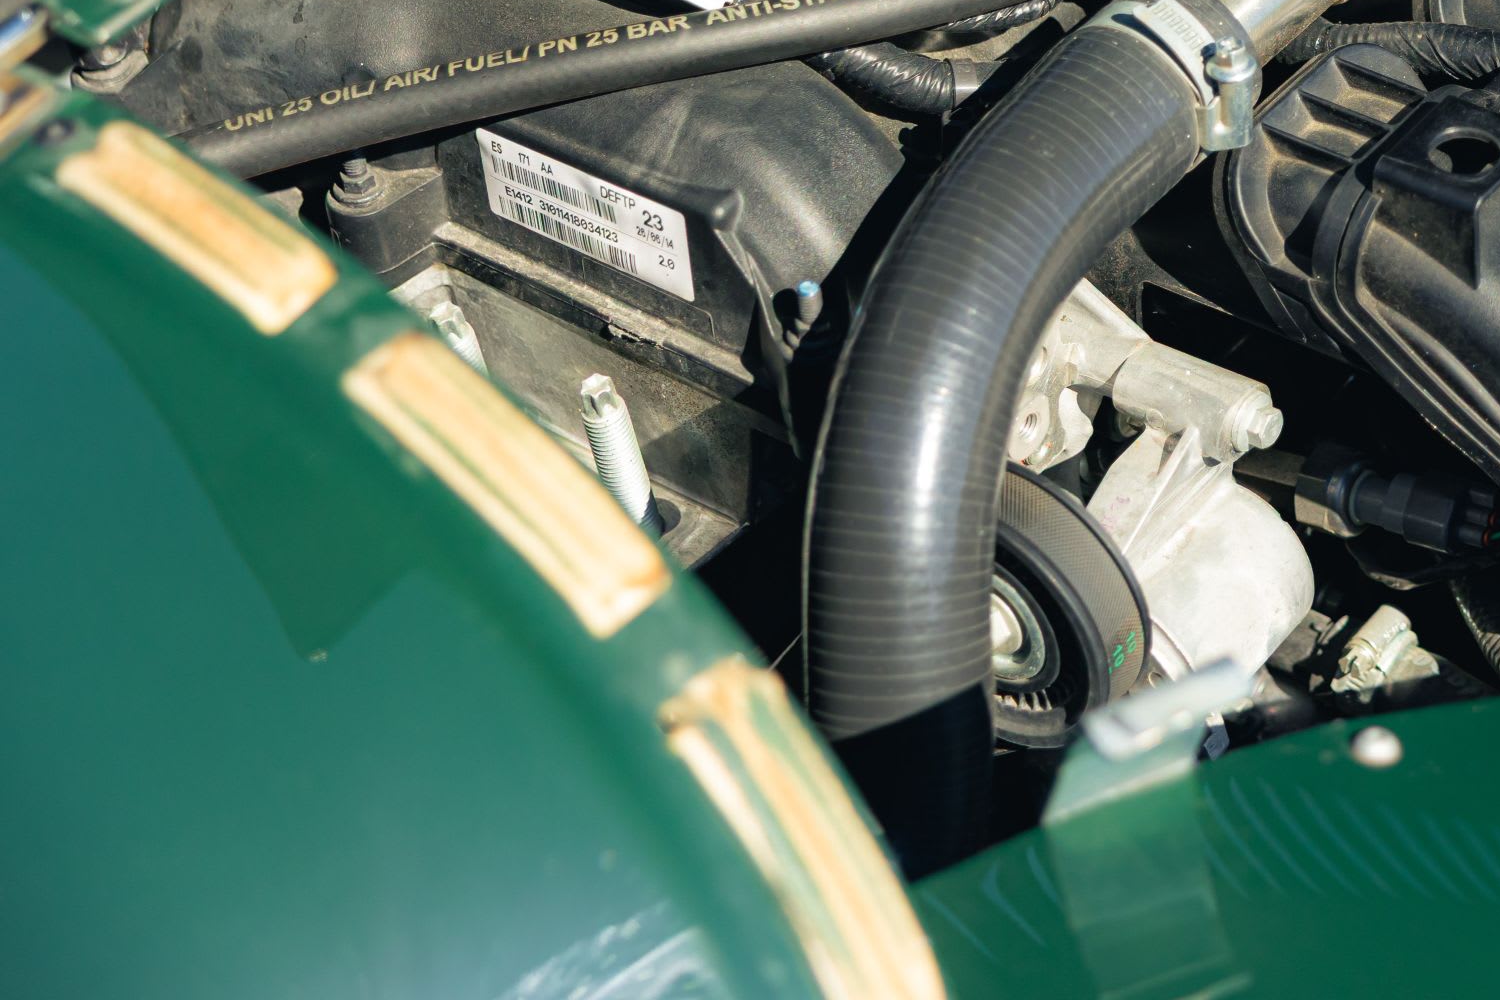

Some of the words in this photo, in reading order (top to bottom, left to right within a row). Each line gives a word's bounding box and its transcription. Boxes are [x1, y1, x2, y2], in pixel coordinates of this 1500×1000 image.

[223, 107, 274, 131] UNI
[282, 96, 313, 117] 25
[320, 79, 376, 105] OIL/
[384, 65, 440, 92] AIR/
[448, 46, 530, 77] FUEL/
[539, 36, 577, 58] PN
[586, 28, 619, 48] 25
[627, 14, 691, 40] BAR
[491, 140, 503, 155] ES
[540, 162, 554, 176] AA
[505, 185, 534, 206] E1412
[641, 209, 665, 232] 23
[658, 254, 676, 271] 2.0
